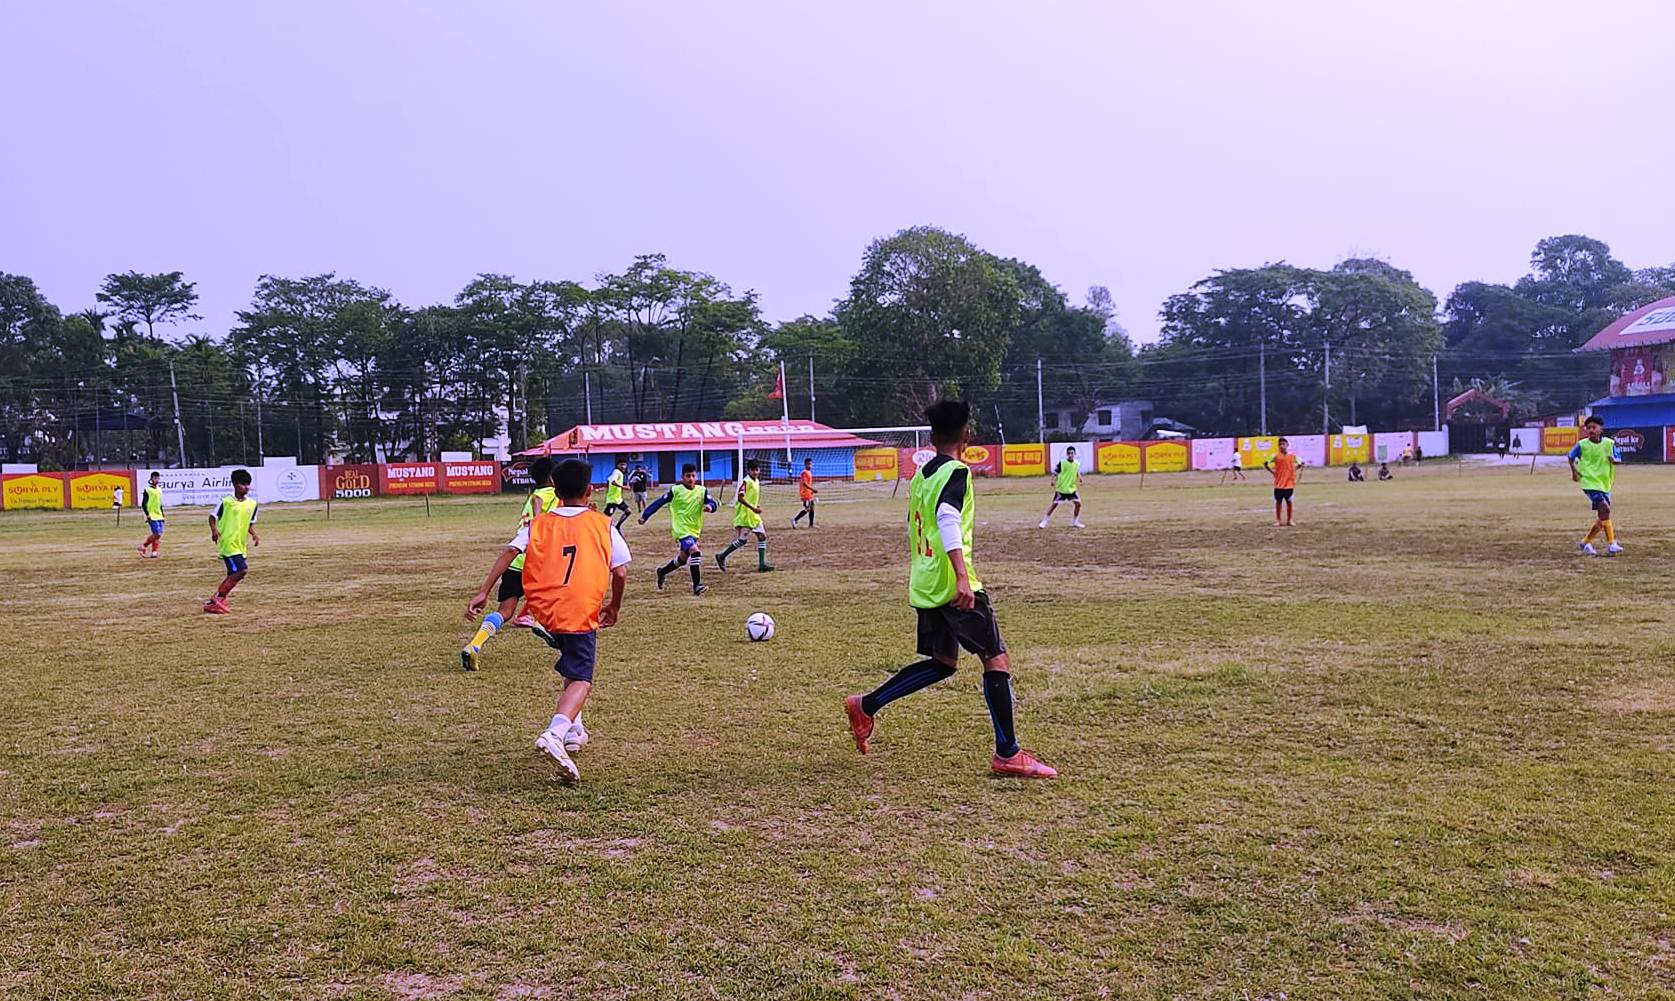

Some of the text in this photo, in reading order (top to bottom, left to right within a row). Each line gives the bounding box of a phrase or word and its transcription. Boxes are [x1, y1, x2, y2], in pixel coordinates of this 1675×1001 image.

[579, 422, 744, 440] MUSTANG
[387, 466, 435, 479] MUSTANG
[446, 465, 493, 477] MUSTANG
[159, 480, 194, 489] aurya
[336, 474, 370, 489] GOLD
[335, 489, 371, 498] 5000
[562, 545, 577, 586] 7
